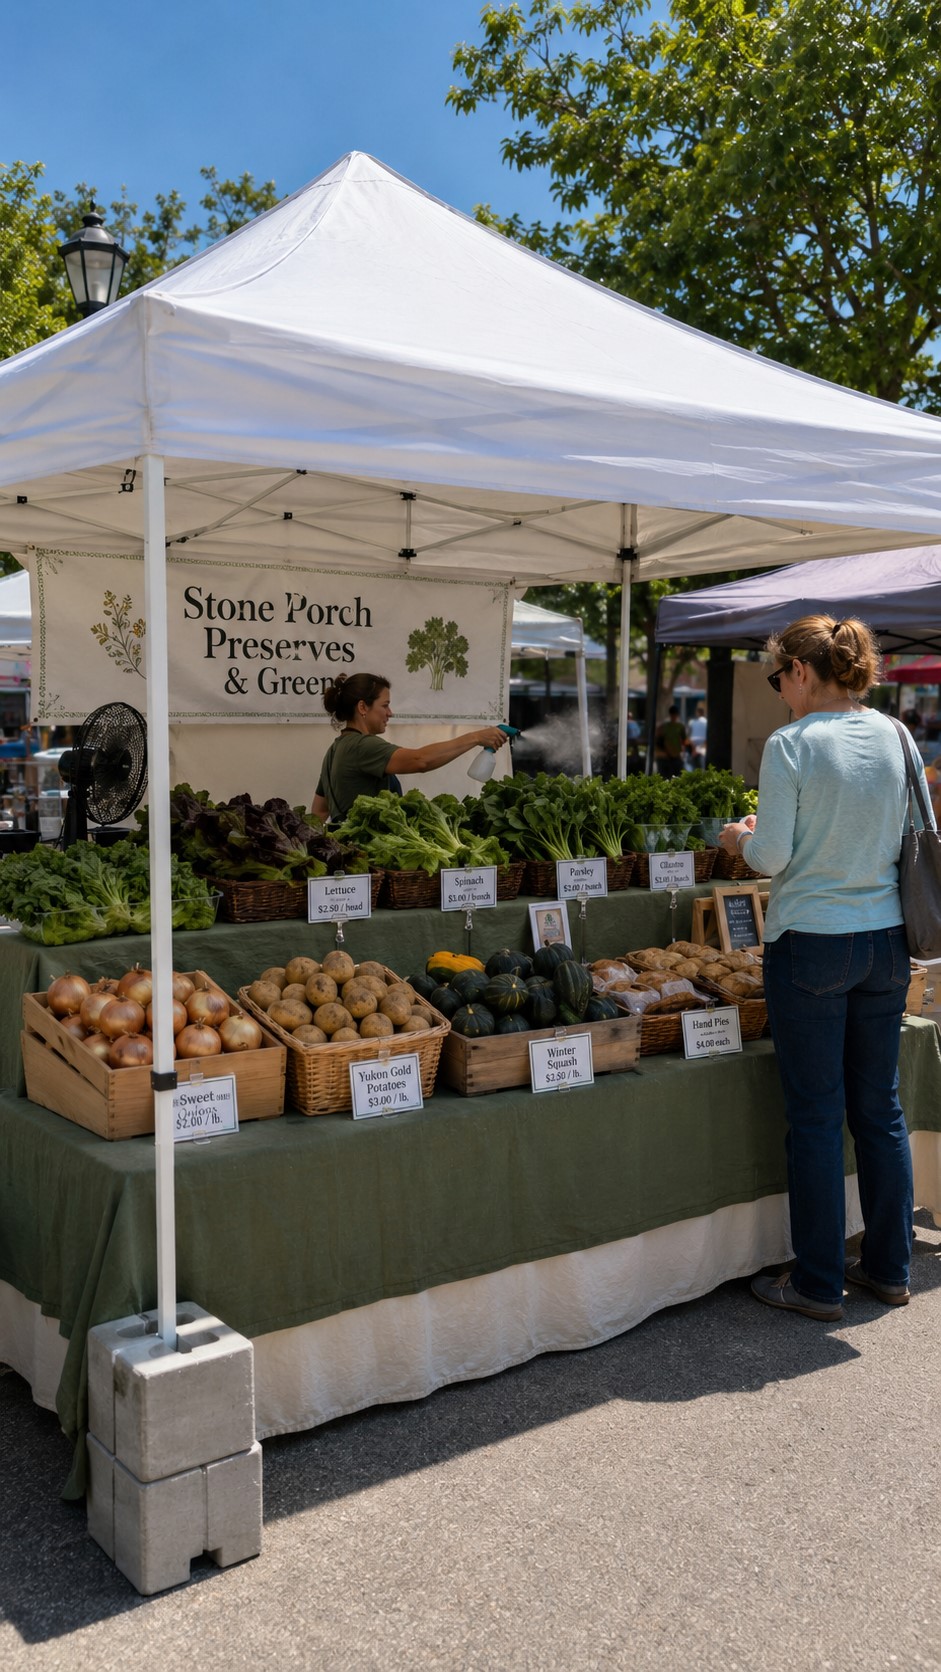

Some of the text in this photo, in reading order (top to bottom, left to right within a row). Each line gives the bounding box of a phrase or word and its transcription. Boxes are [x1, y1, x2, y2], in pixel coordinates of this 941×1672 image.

[184, 586, 373, 628] Stone Porch
[204, 627, 355, 663] Preserves
[224, 667, 336, 696] & Green
[454, 876, 484, 888] Spinach
[325, 886, 356, 896] Lettuce
[692, 1018, 730, 1029] Hand Pies
[715, 1037, 731, 1047] each
[547, 1047, 576, 1058] Winter
[547, 1057, 578, 1070] Squash
[358, 1064, 412, 1082] Yukon Gold
[367, 1080, 407, 1094] Potatoes
[180, 1091, 215, 1106] Sweet
[368, 1092, 409, 1108] $3.00 / lb.
[211, 1111, 223, 1124] lb.
